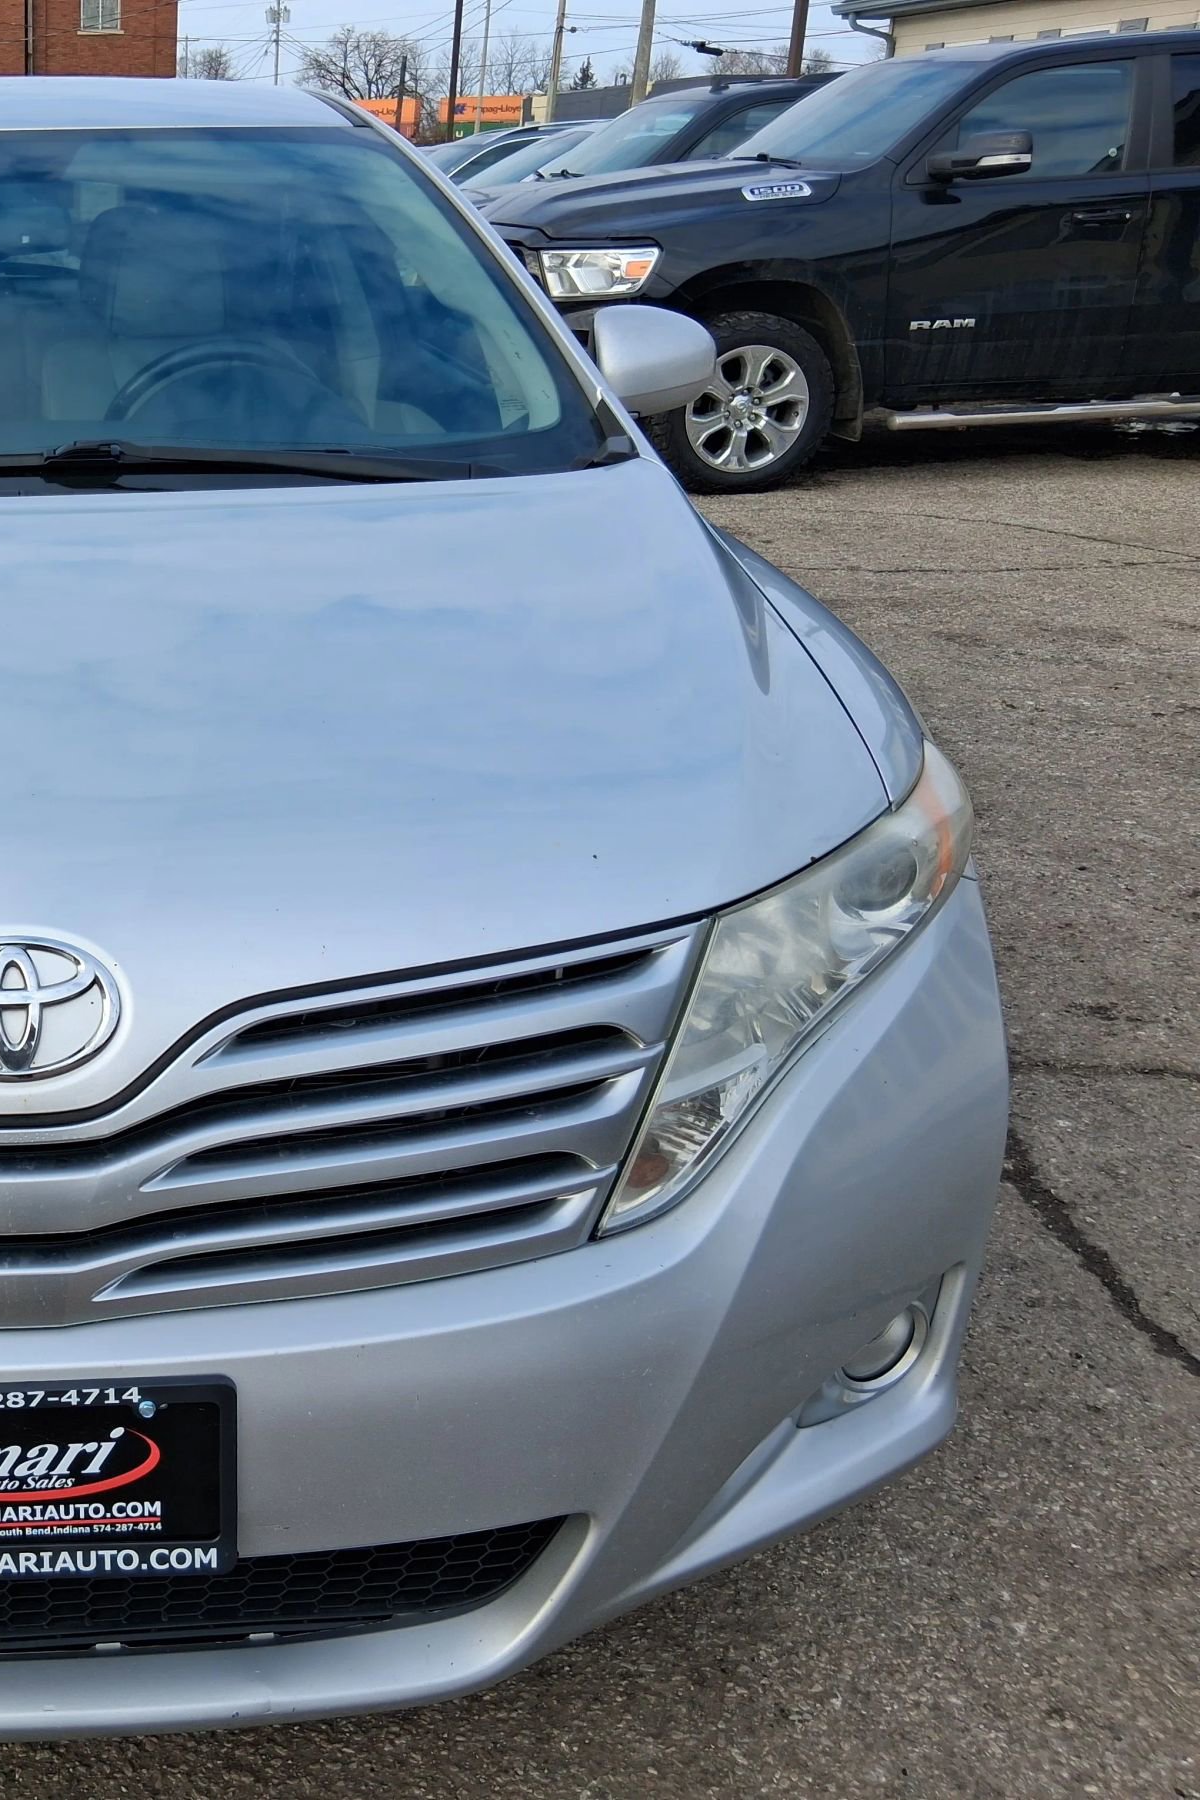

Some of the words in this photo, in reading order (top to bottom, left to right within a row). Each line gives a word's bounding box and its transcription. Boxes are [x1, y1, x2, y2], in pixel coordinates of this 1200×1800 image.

[750, 184, 801, 195] 1500
[909, 318, 976, 331] RAM
[23, 1474, 76, 1490] Sales
[92, 1522, 163, 1533] 574-287-4714
